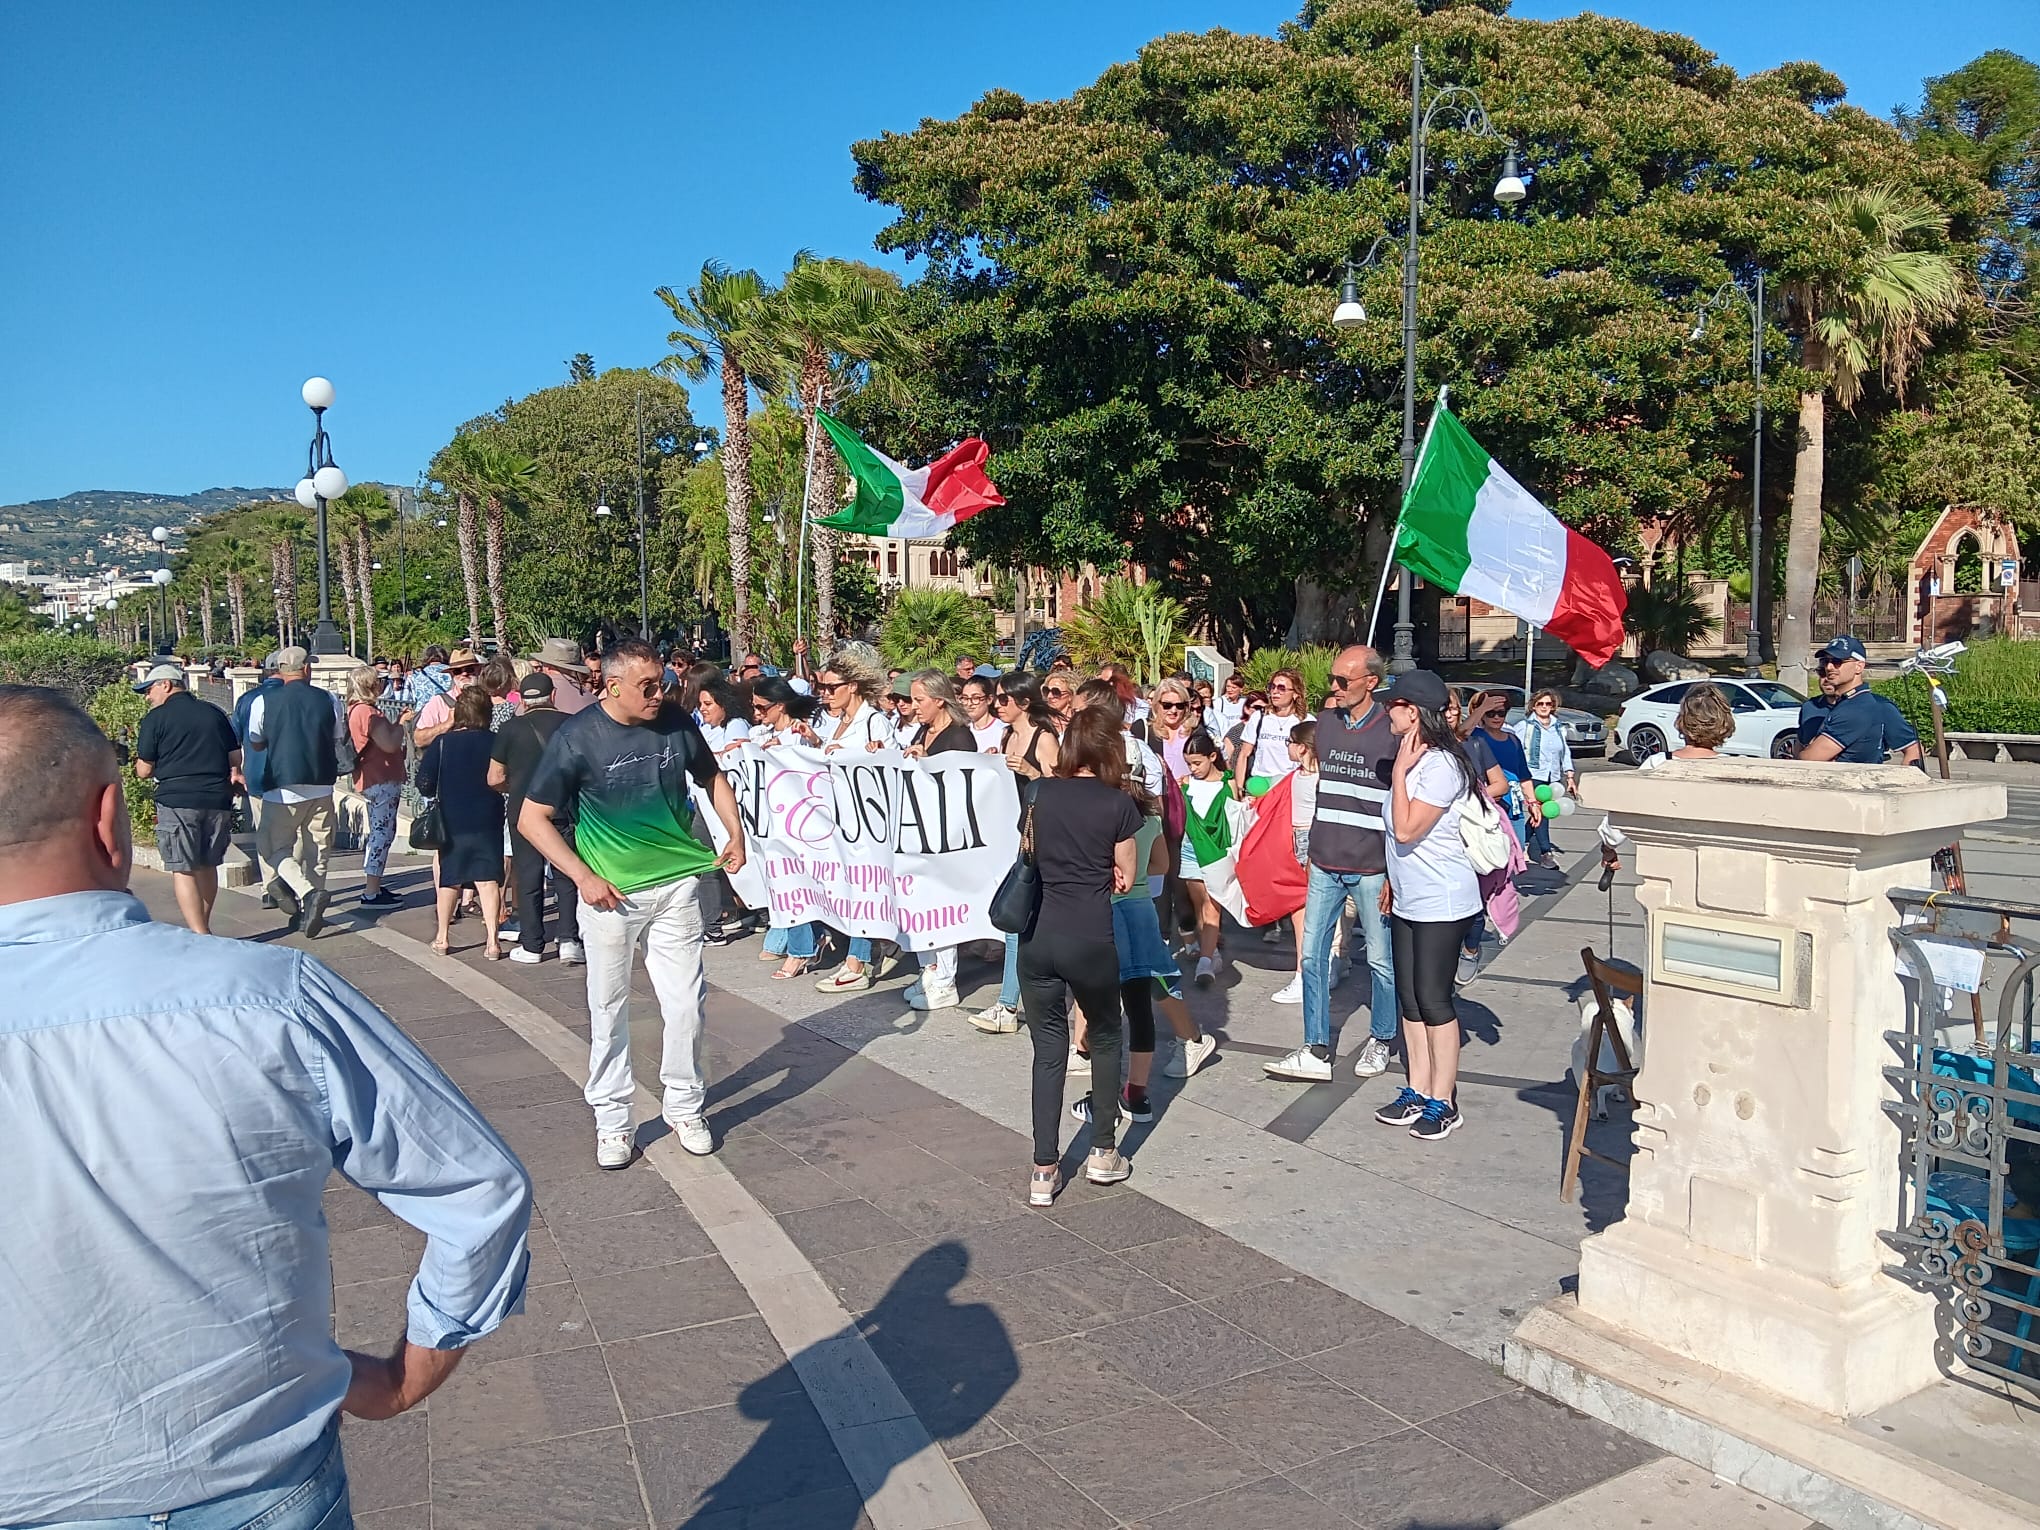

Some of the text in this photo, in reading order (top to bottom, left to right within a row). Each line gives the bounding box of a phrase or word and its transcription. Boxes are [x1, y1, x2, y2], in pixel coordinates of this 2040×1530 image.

[1329, 750, 1365, 764] Polizia
[1319, 761, 1377, 780] Municipale
[782, 853, 805, 875] noi
[812, 860, 841, 882] per
[897, 903, 969, 934] Donne
